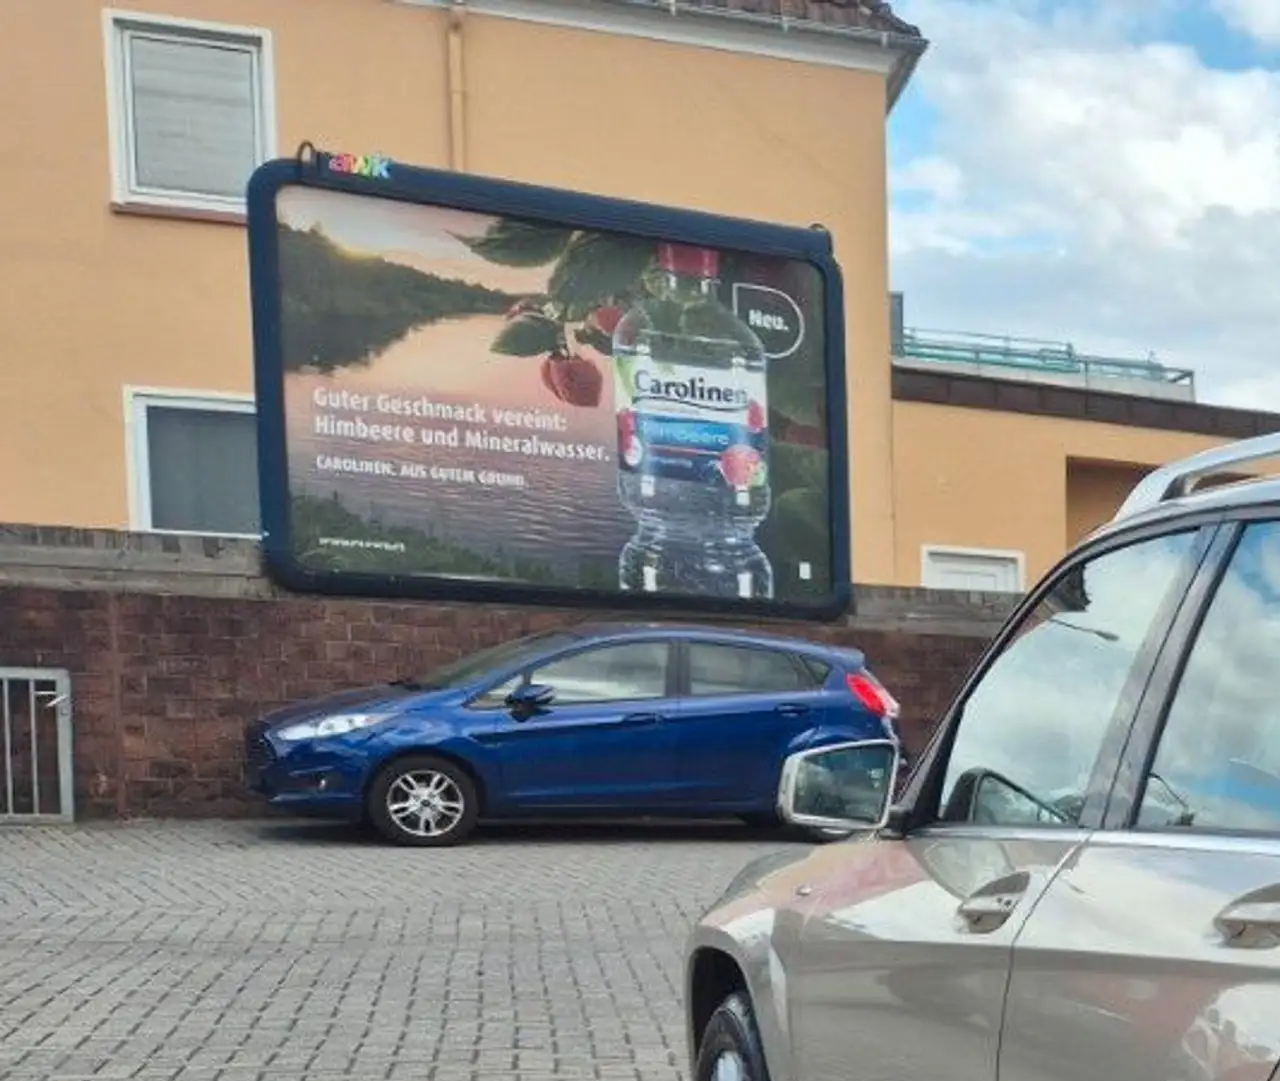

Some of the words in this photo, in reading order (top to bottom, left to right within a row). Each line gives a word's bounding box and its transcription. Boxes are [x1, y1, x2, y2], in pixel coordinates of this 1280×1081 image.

[749, 309, 790, 331] Neu.
[635, 369, 749, 404] Carolinen
[313, 386, 369, 413] Guter
[376, 393, 486, 424] Geschmack
[492, 408, 568, 432] vereint:
[314, 415, 415, 443] Himbeere
[421, 428, 459, 448] und
[464, 431, 611, 461] Mineralwasser.
[400, 464, 427, 480] AUS
